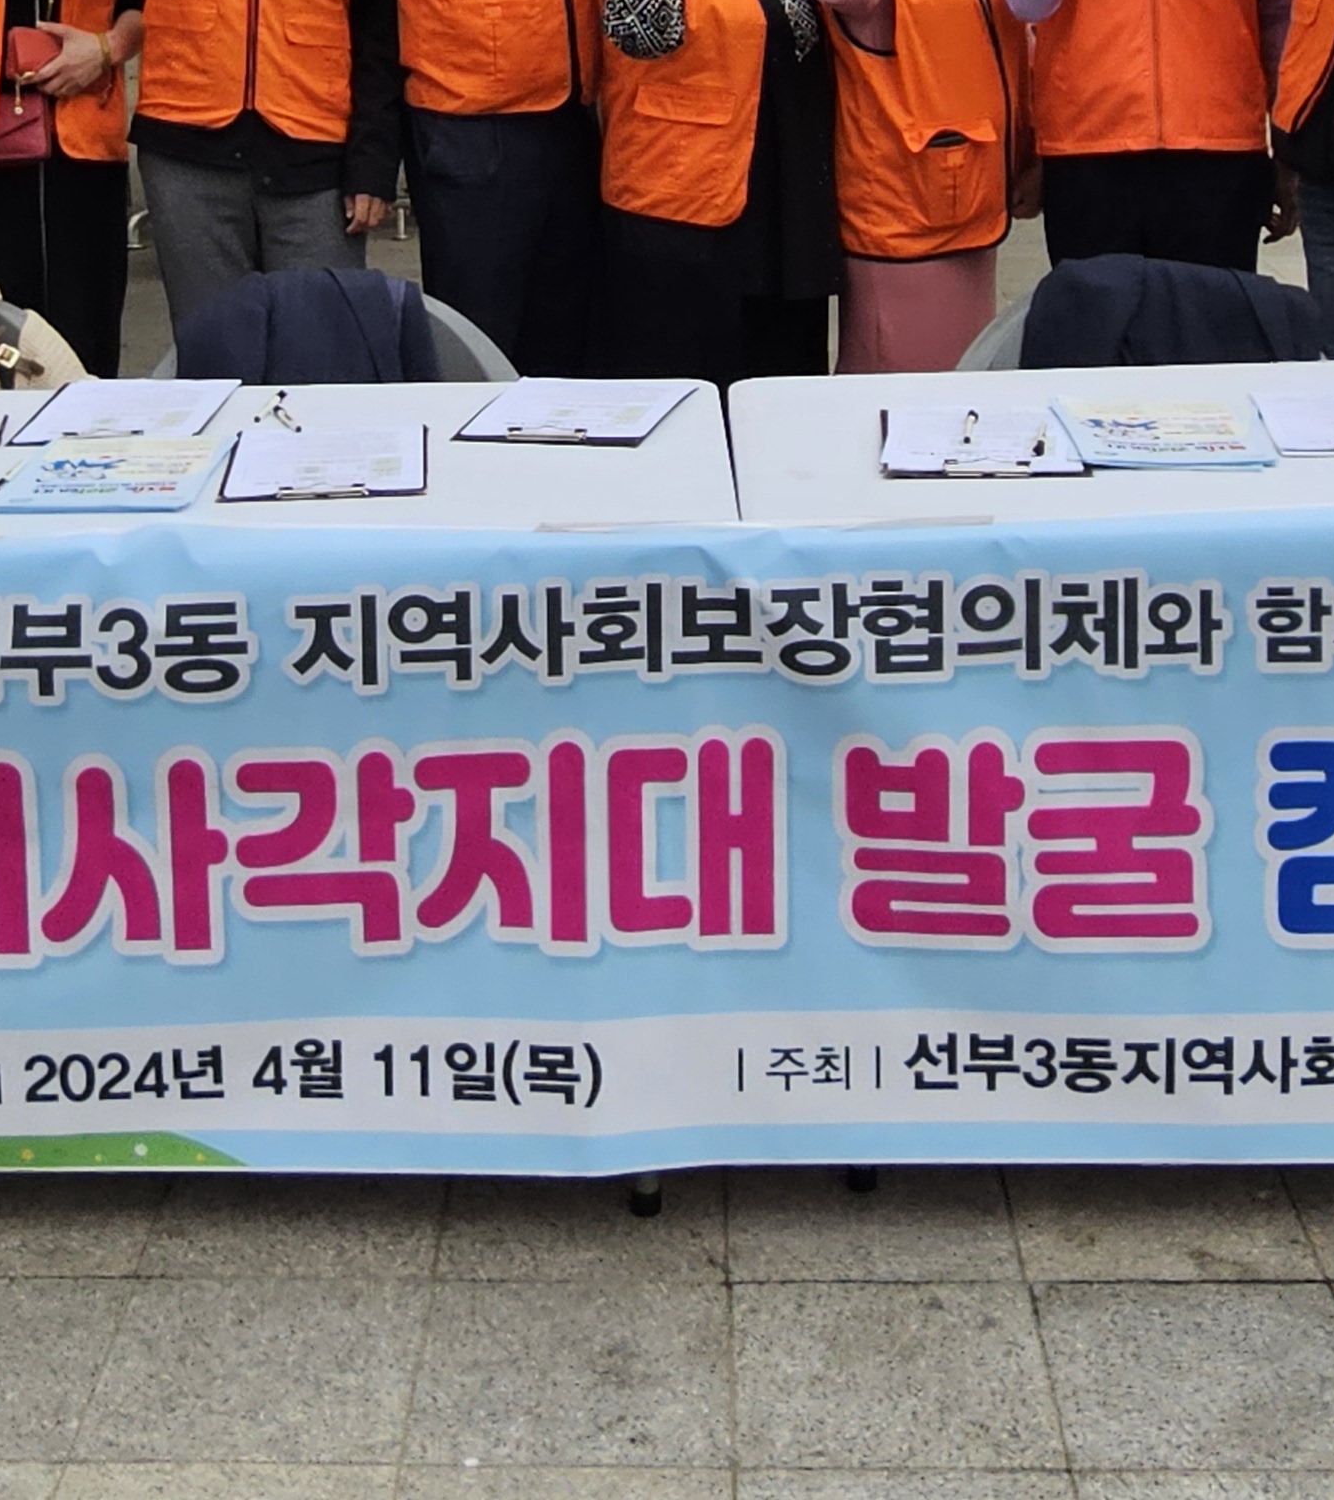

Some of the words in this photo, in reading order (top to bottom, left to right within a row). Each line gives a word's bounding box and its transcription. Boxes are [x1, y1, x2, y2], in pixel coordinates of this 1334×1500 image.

[291, 576, 1223, 687] 지역사회보장협의체와
[843, 740, 1201, 940] 발굴
[23, 1047, 226, 1104] 2024년
[252, 1037, 346, 1101] 4월
[373, 1040, 604, 1109] 11일(목)
[764, 1044, 852, 1091] 주최
